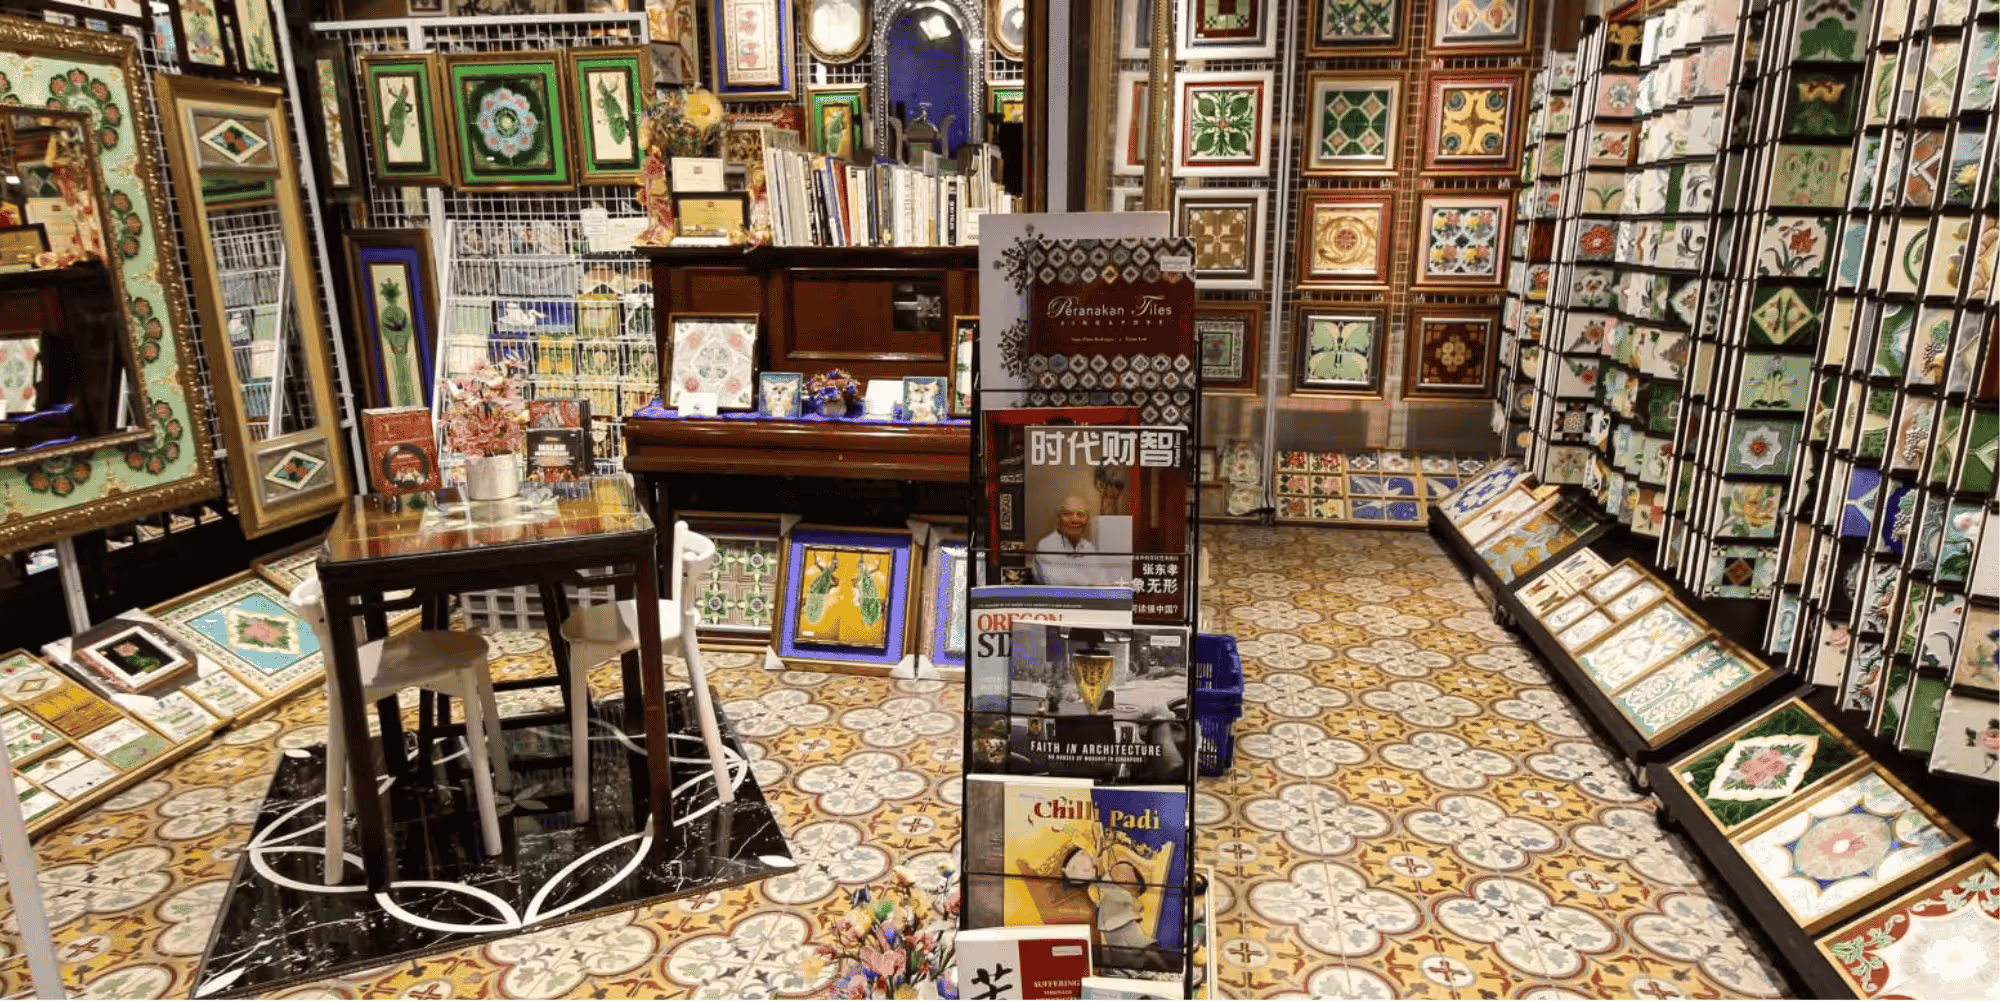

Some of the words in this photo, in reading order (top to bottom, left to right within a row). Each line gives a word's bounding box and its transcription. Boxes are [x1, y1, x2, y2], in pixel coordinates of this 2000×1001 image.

[1046, 295, 1125, 318] Peranakan
[1130, 294, 1173, 317] Tiles
[1031, 430, 1174, 468] 时代财智
[1030, 740, 1060, 753] FAITH
[1066, 743, 1078, 754] IN
[1082, 743, 1161, 757] ARCHITECTURE
[1034, 799, 1101, 821] Chilli
[1109, 808, 1161, 830] Padi
[1033, 979, 1080, 988] SUFFERING
